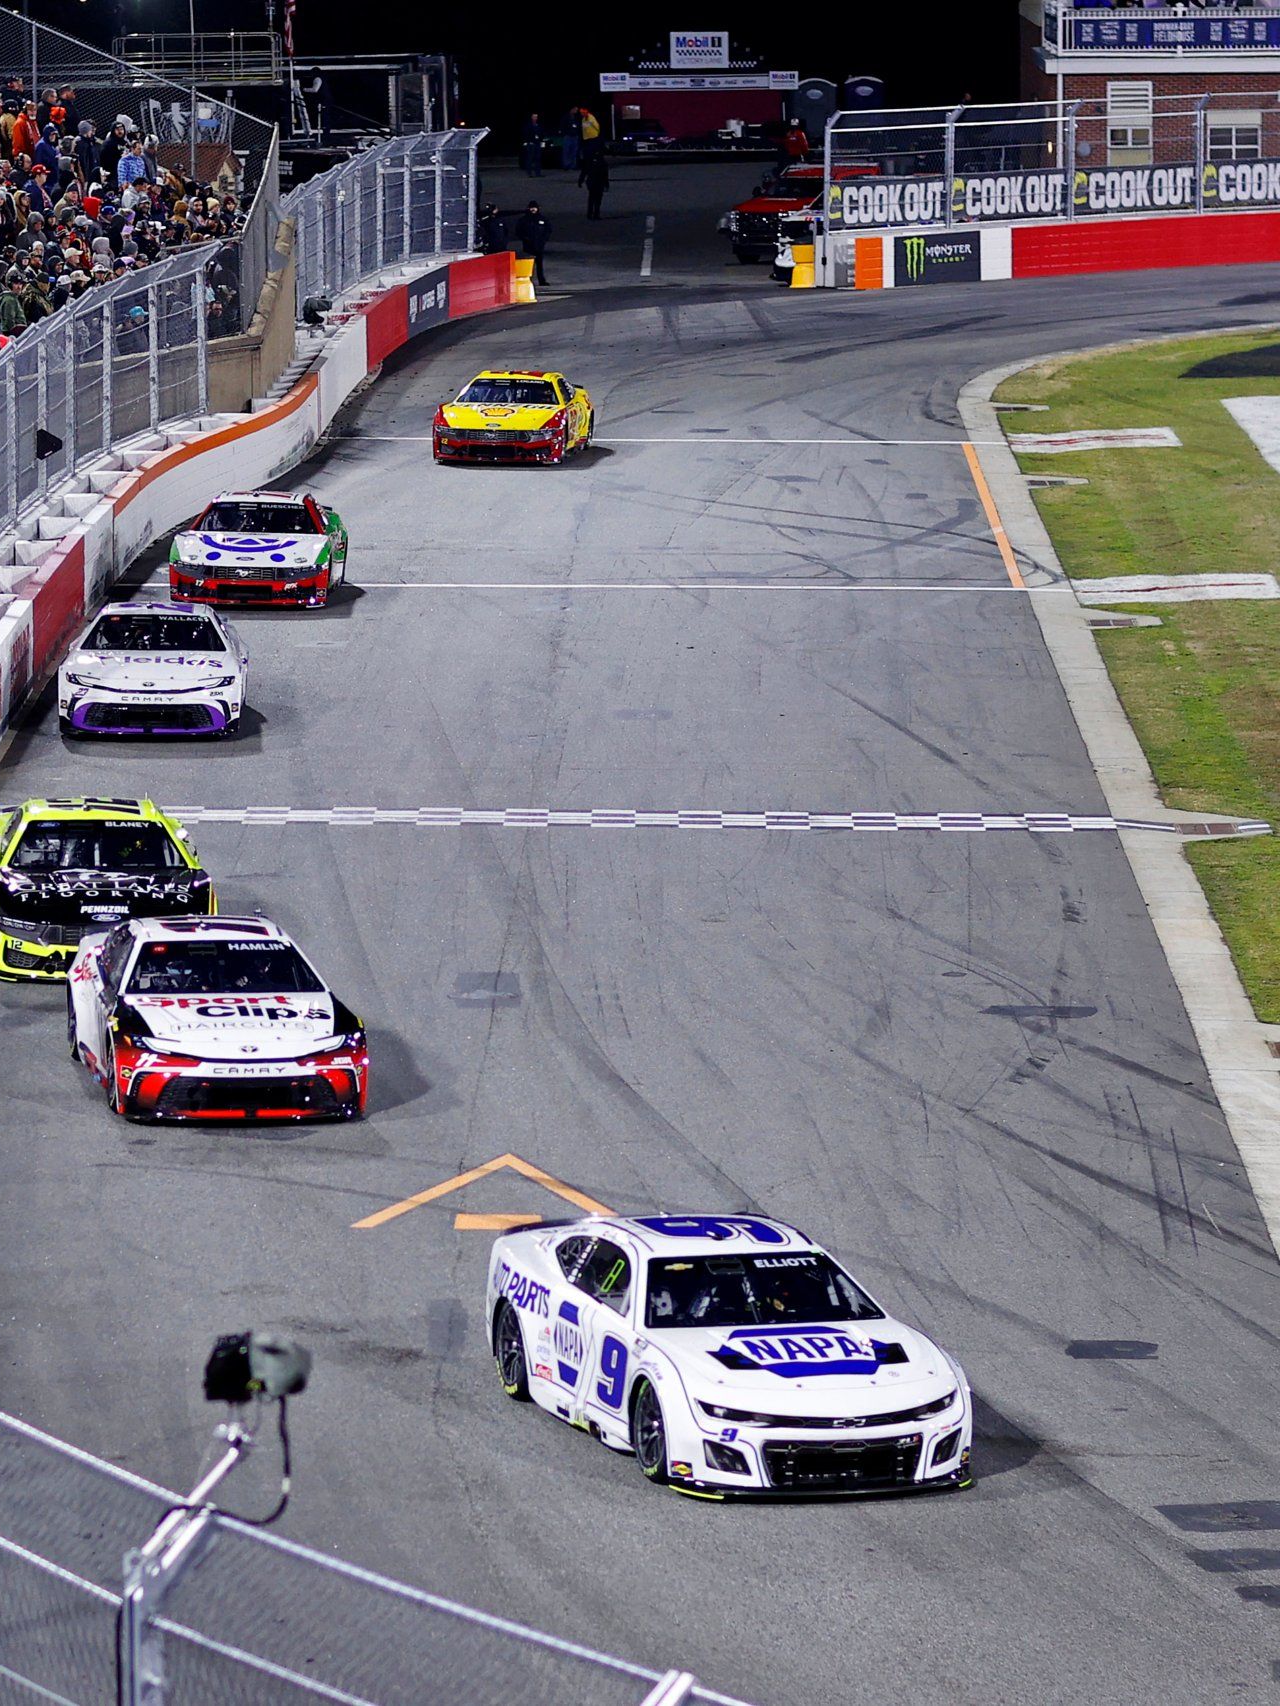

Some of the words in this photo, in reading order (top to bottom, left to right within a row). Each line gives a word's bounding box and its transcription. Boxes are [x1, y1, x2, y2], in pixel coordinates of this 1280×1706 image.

[676, 37, 709, 48] Mobil
[1153, 31, 1195, 42] FIELDHOUSE
[1089, 170, 1151, 209] COOK
[1152, 166, 1195, 206] OUT
[1219, 163, 1280, 202] COOK
[966, 176, 1024, 216] COOK
[1025, 173, 1065, 214] OUT
[842, 185, 903, 224] COOK
[904, 181, 944, 221] OUT
[925, 244, 972, 258] MONSTER
[195, 579, 205, 588] 17
[123, 655, 224, 669] leidos
[18, 881, 103, 892] GREAT
[114, 881, 192, 893] LAKES
[20, 891, 190, 902] FLOORING
[80, 905, 130, 914] PENNZOIL
[94, 914, 119, 922] Ford
[11, 940, 23, 950] 12
[228, 943, 285, 951] HAMLIN
[138, 995, 293, 1008] Sport
[196, 1005, 332, 1020] Clips
[177, 1021, 308, 1030] HAIRCUTS
[213, 1066, 287, 1074] CAMRY
[754, 1257, 818, 1268] ELLIOTT
[508, 1271, 551, 1319] PARTS
[557, 1321, 581, 1365] NAPA
[741, 1336, 873, 1362] NAPA
[597, 1335, 629, 1410] 9
[720, 1428, 738, 1442] 9
